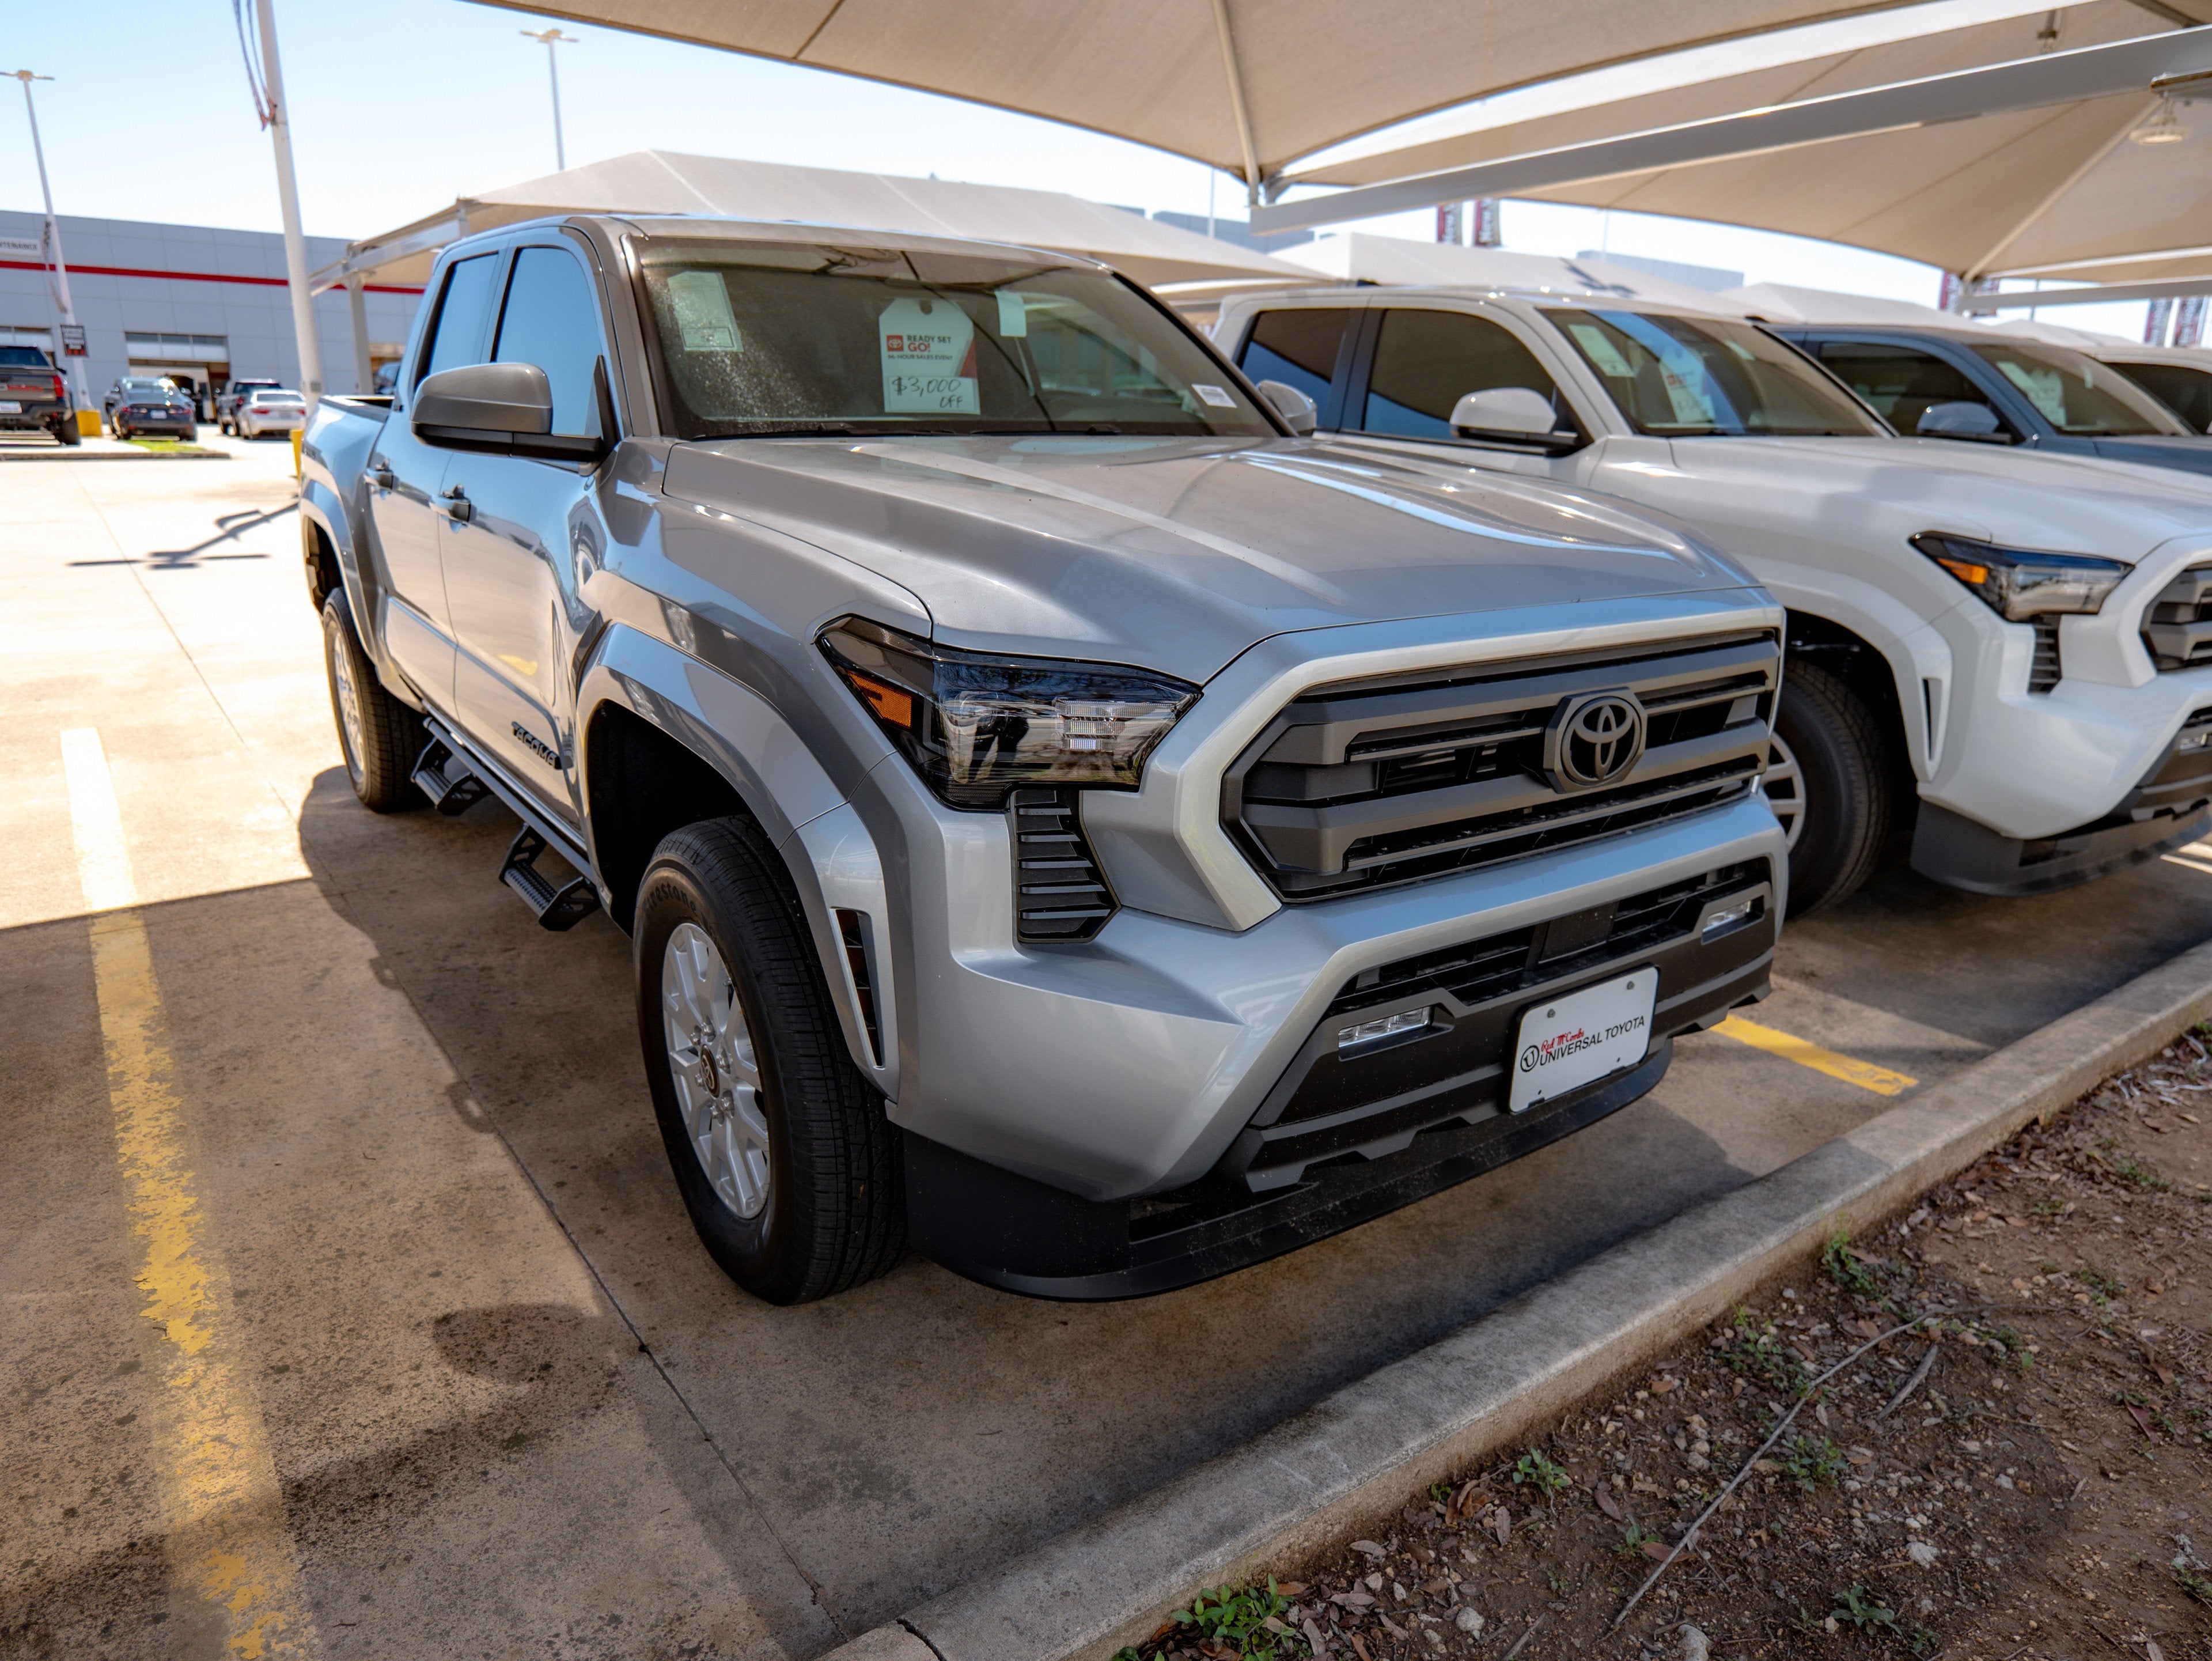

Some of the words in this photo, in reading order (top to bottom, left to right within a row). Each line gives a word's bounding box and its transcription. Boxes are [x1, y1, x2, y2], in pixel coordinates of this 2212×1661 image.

[908, 342, 930, 352] GO!
[892, 376, 961, 397] $3,000
[512, 721, 559, 769] TACOMA
[1540, 1032, 1603, 1066] UNIVERSAL
[1605, 1016, 1645, 1041] TOYOTA
[1541, 1037, 1554, 1054] Red
